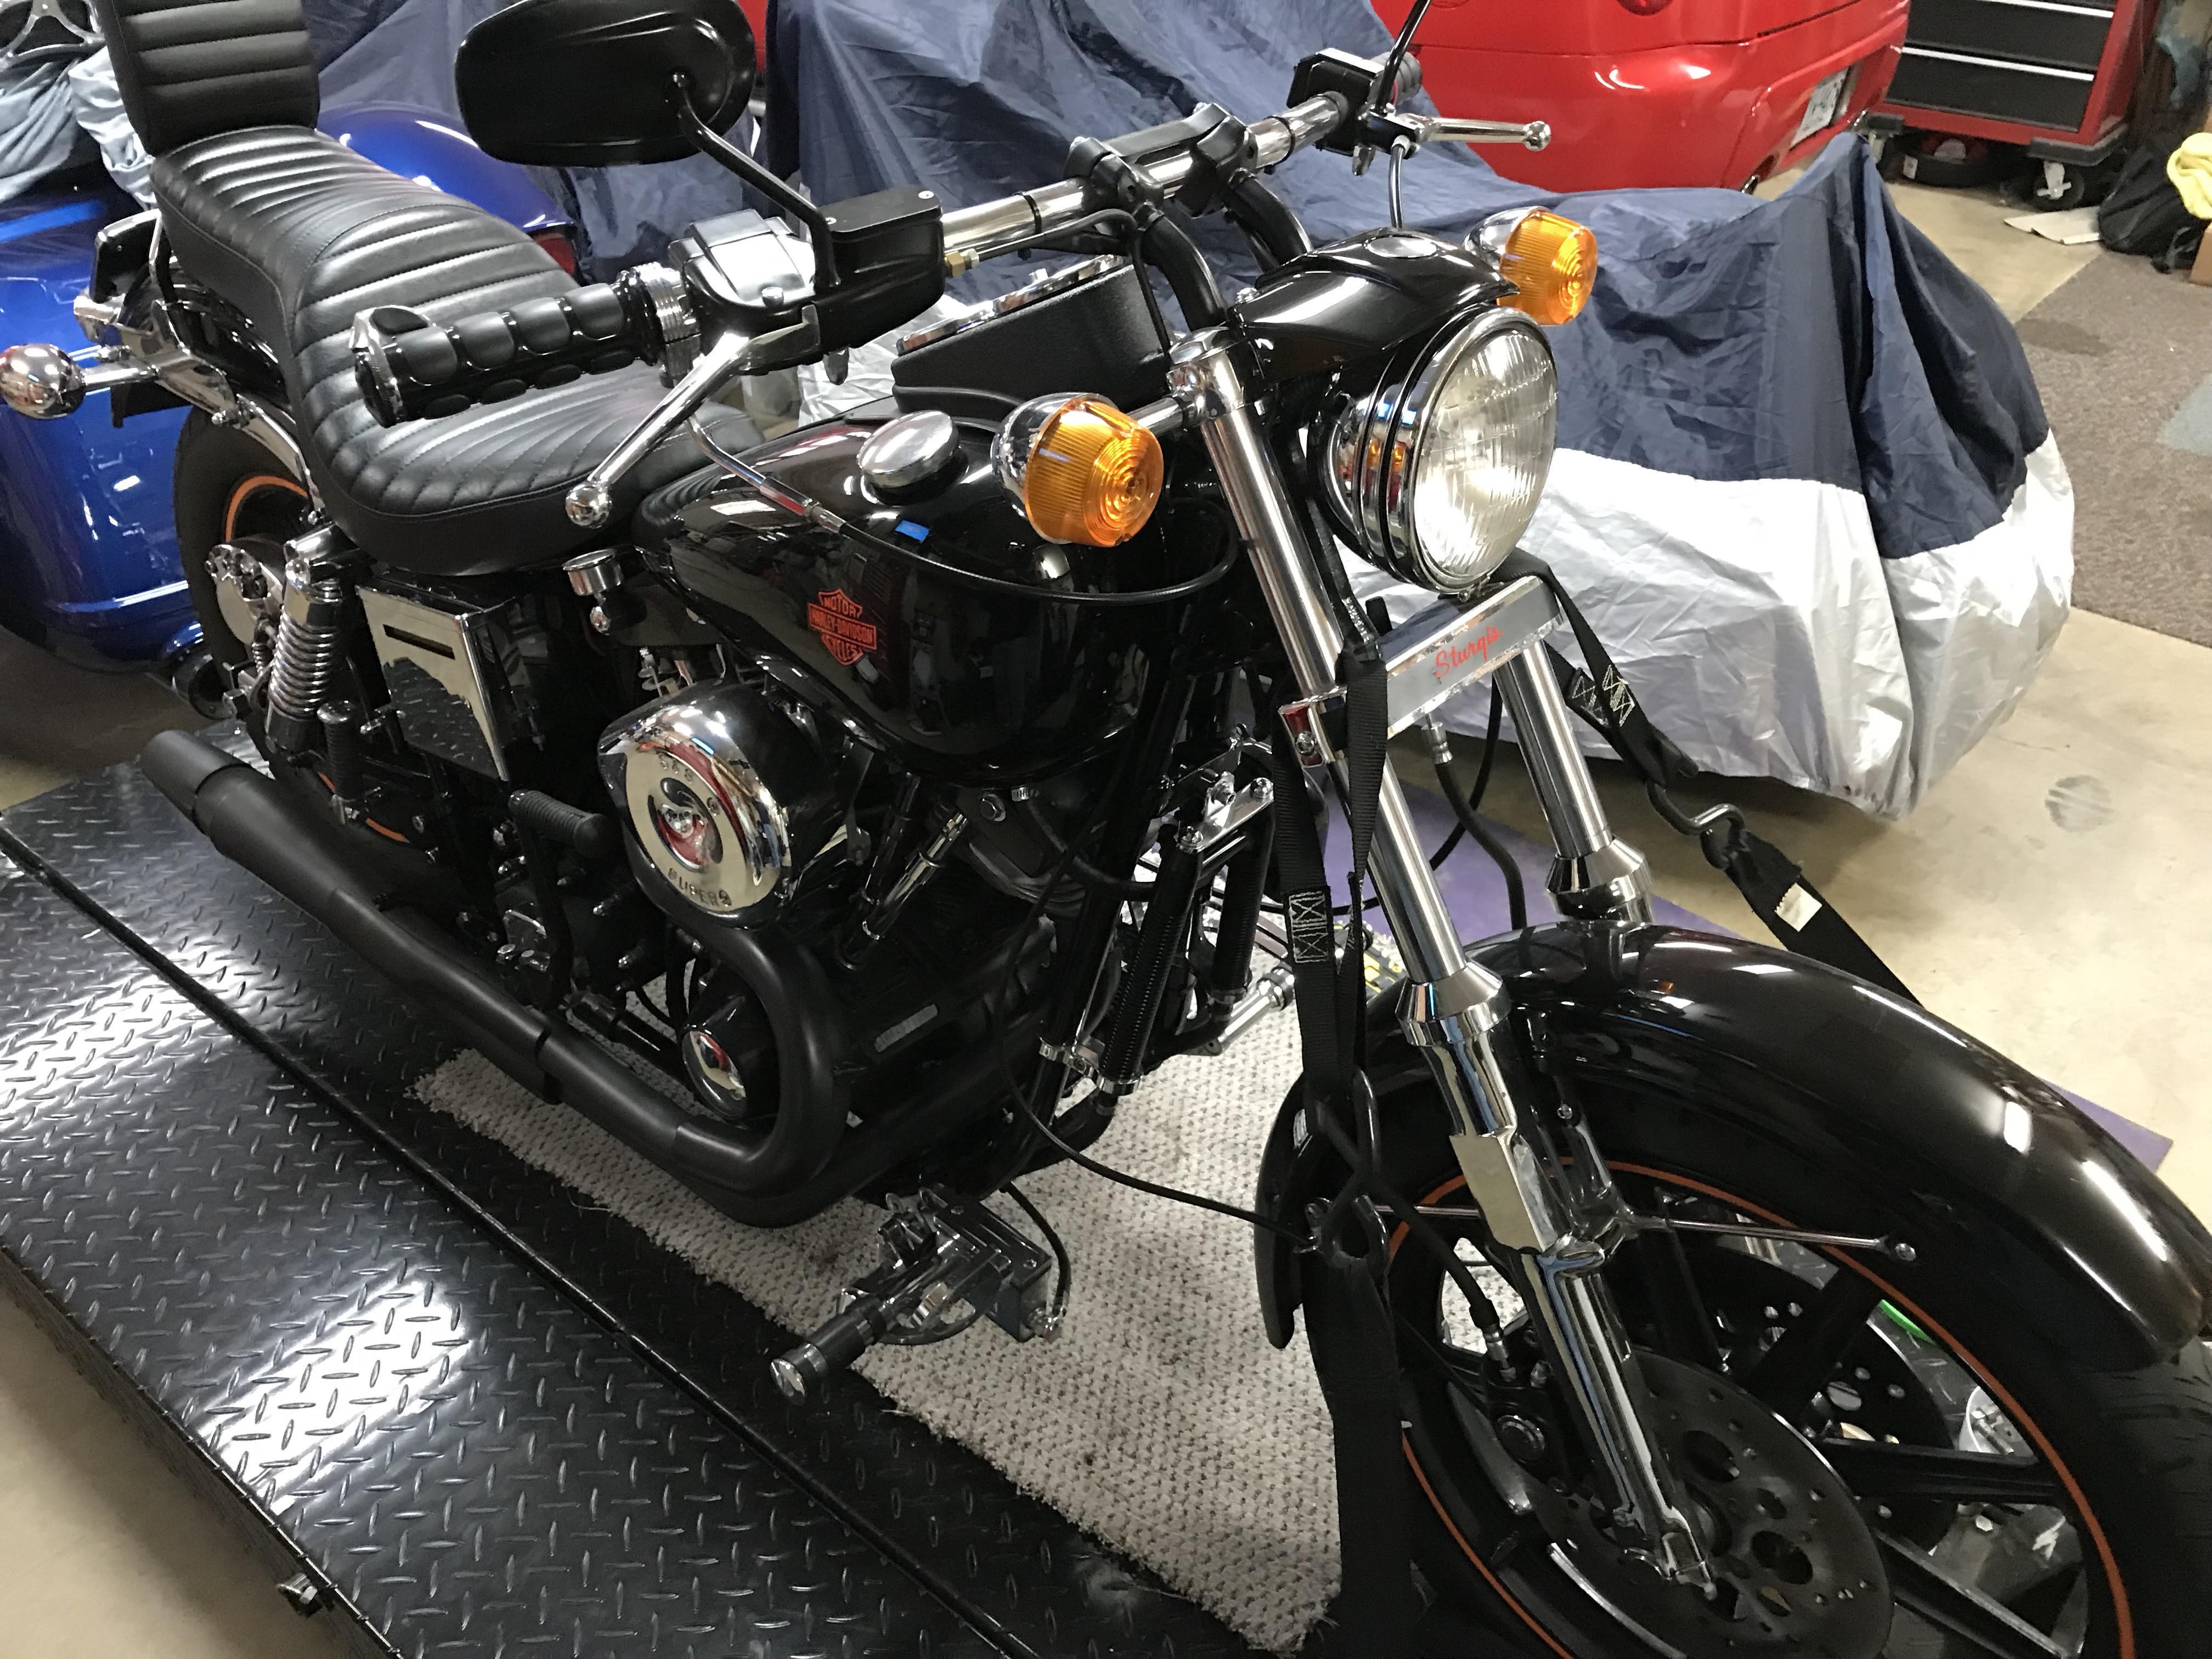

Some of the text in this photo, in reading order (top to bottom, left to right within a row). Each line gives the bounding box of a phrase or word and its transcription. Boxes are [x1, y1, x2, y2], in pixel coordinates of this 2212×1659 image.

[824, 594, 857, 618] MOTOR
[811, 607, 873, 644] HARLEY-DAVIDSON
[1434, 626, 1504, 678] Sturgis
